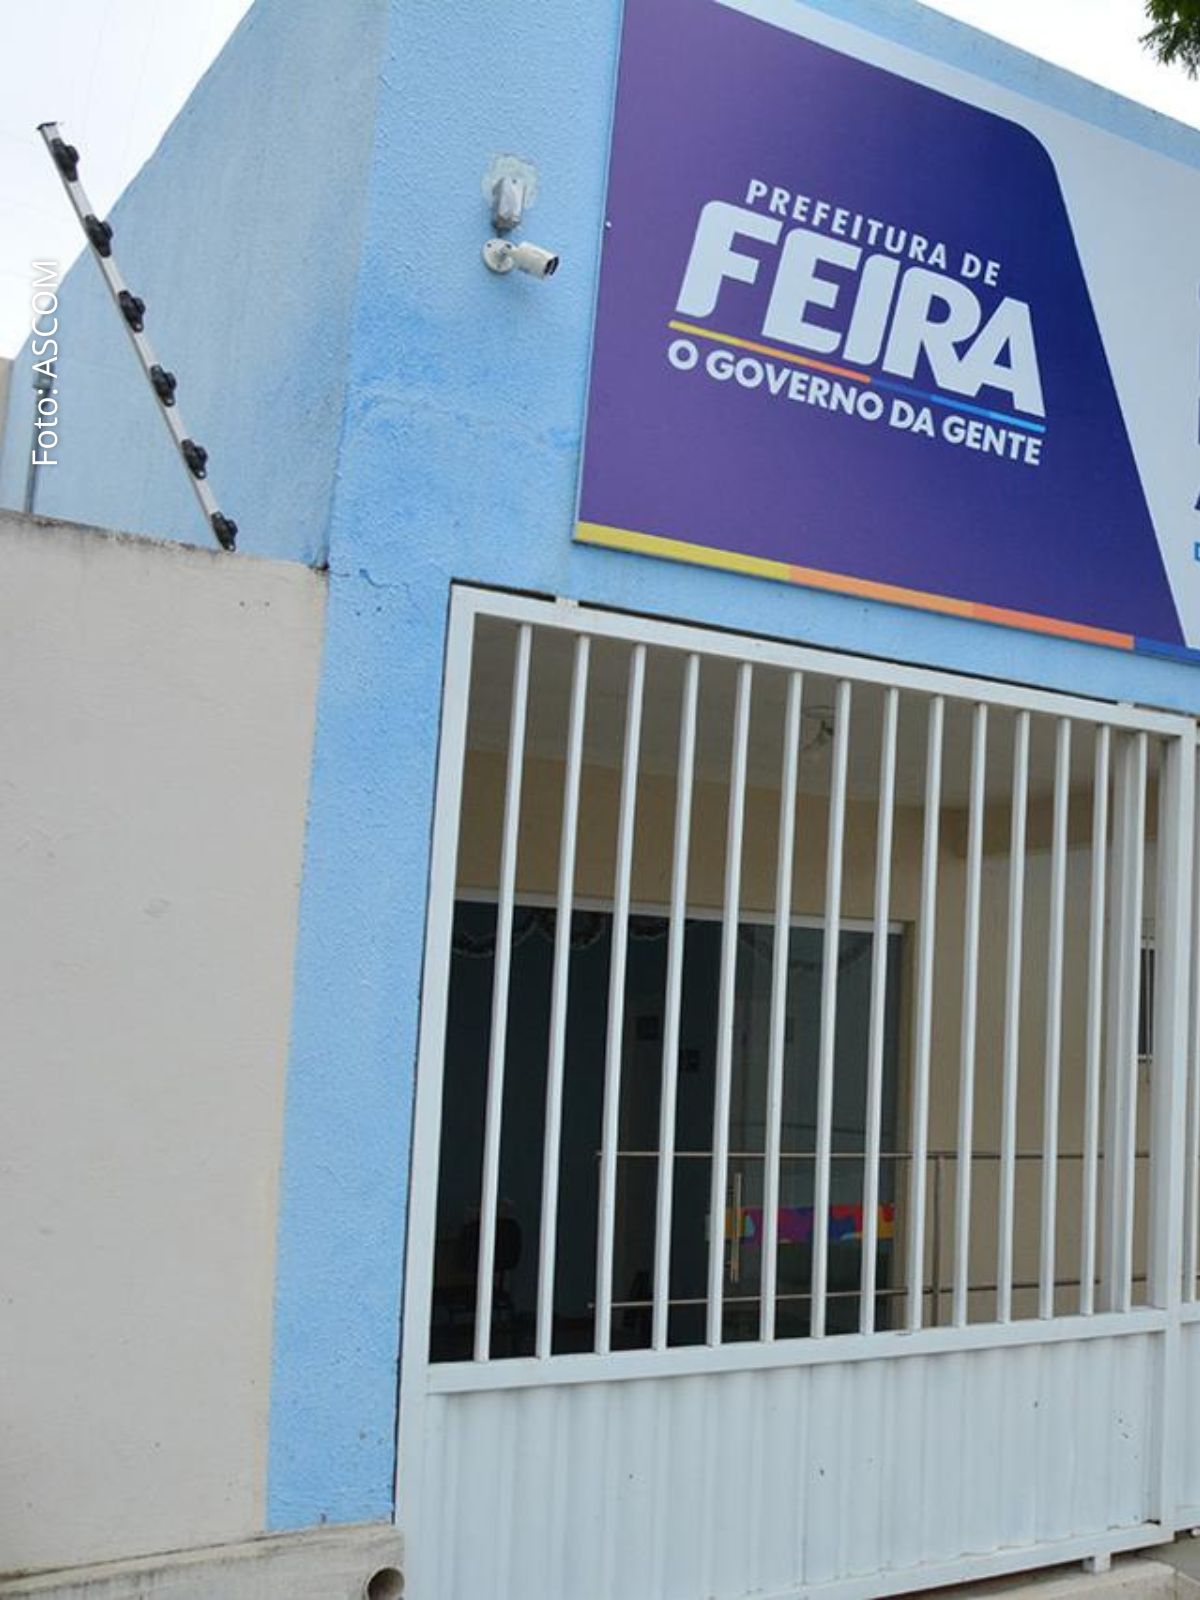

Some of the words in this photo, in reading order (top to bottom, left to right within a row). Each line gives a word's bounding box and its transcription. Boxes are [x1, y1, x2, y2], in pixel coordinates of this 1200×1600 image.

[746, 179, 948, 270] PREFEITURA
[962, 251, 1001, 287] DE
[675, 200, 1046, 417] FEIRA
[668, 339, 699, 370] O
[706, 349, 883, 421] GOVERNO
[889, 400, 934, 438] DA
[943, 415, 1042, 466] GENTE
